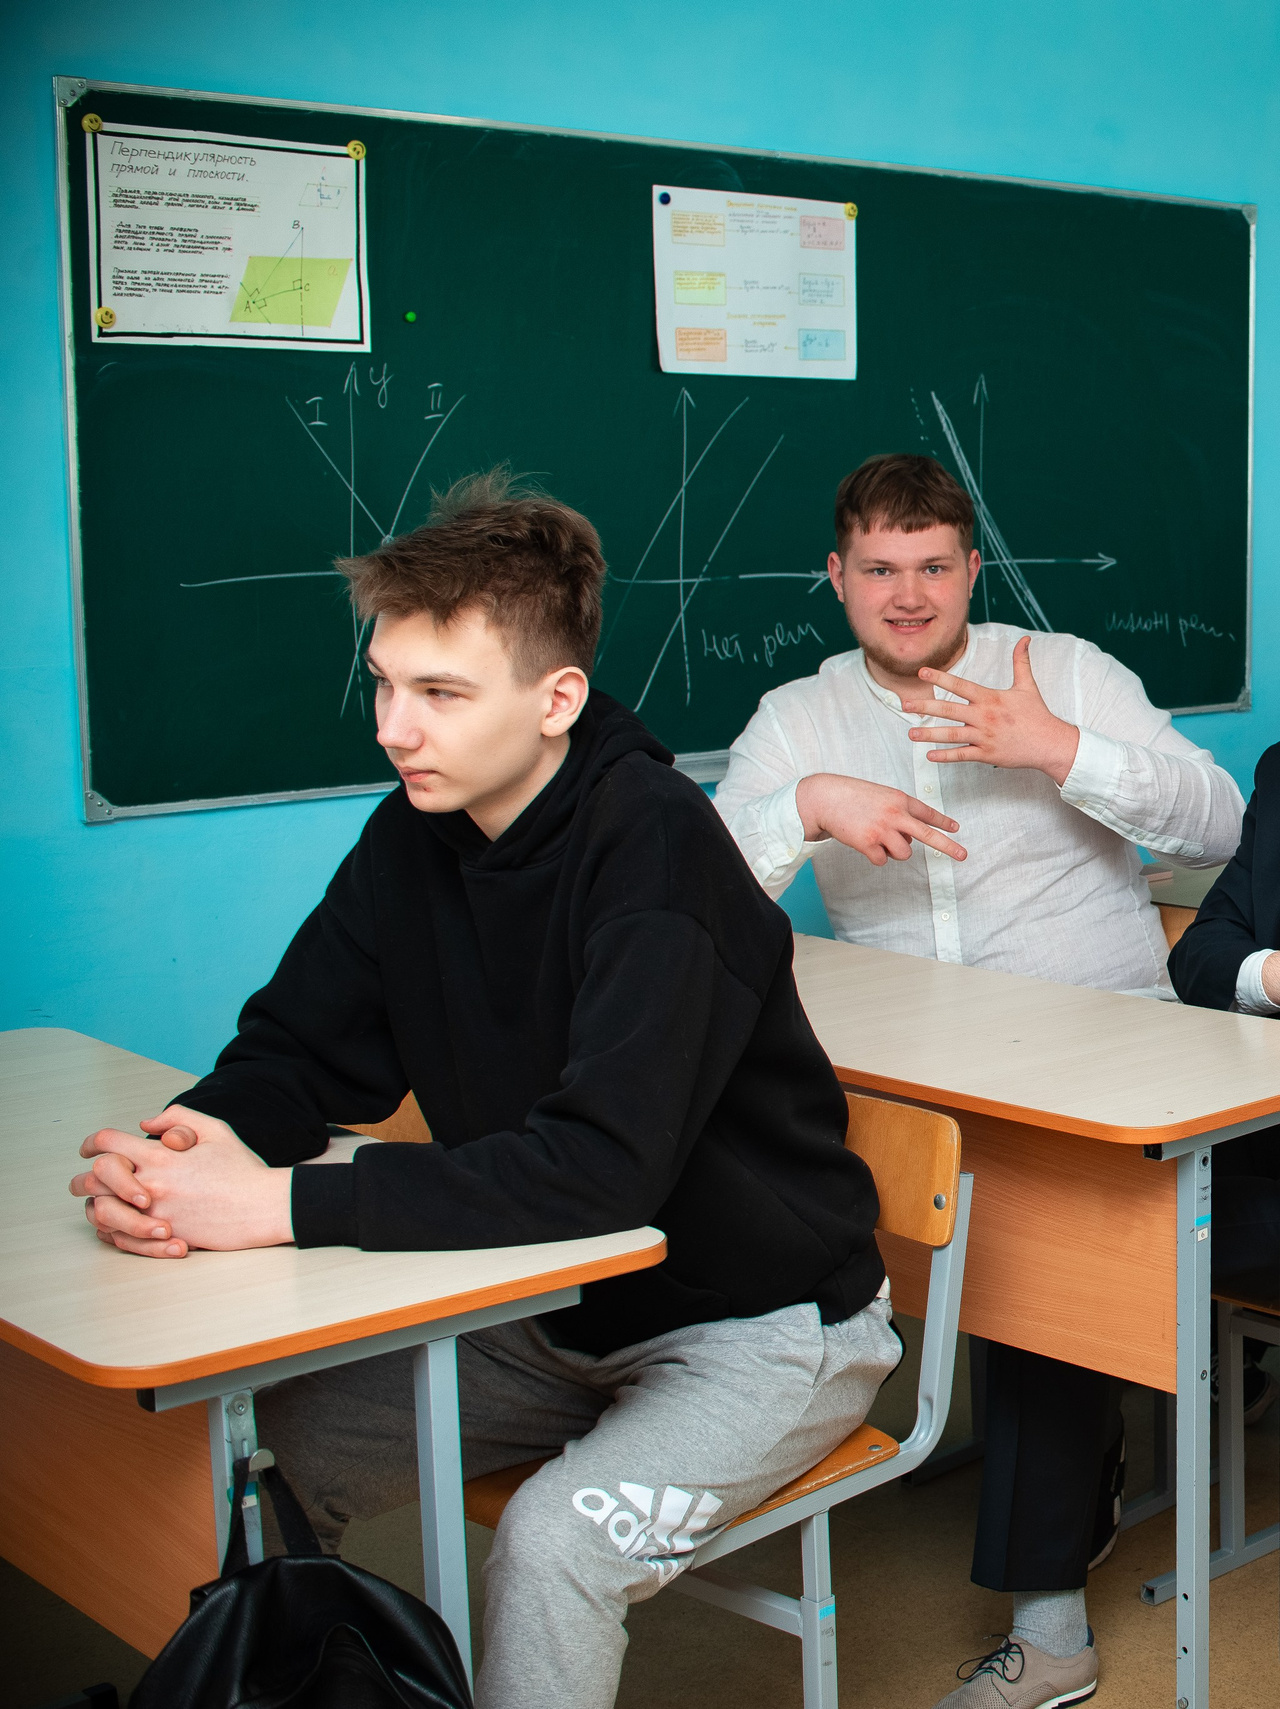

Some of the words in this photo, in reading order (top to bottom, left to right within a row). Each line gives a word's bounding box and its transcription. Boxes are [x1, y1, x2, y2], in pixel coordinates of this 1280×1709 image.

[110, 141, 257, 167] Перпендикулярность
[111, 162, 159, 178] прямой
[168, 168, 177, 177] и
[292, 220, 301, 230] B
